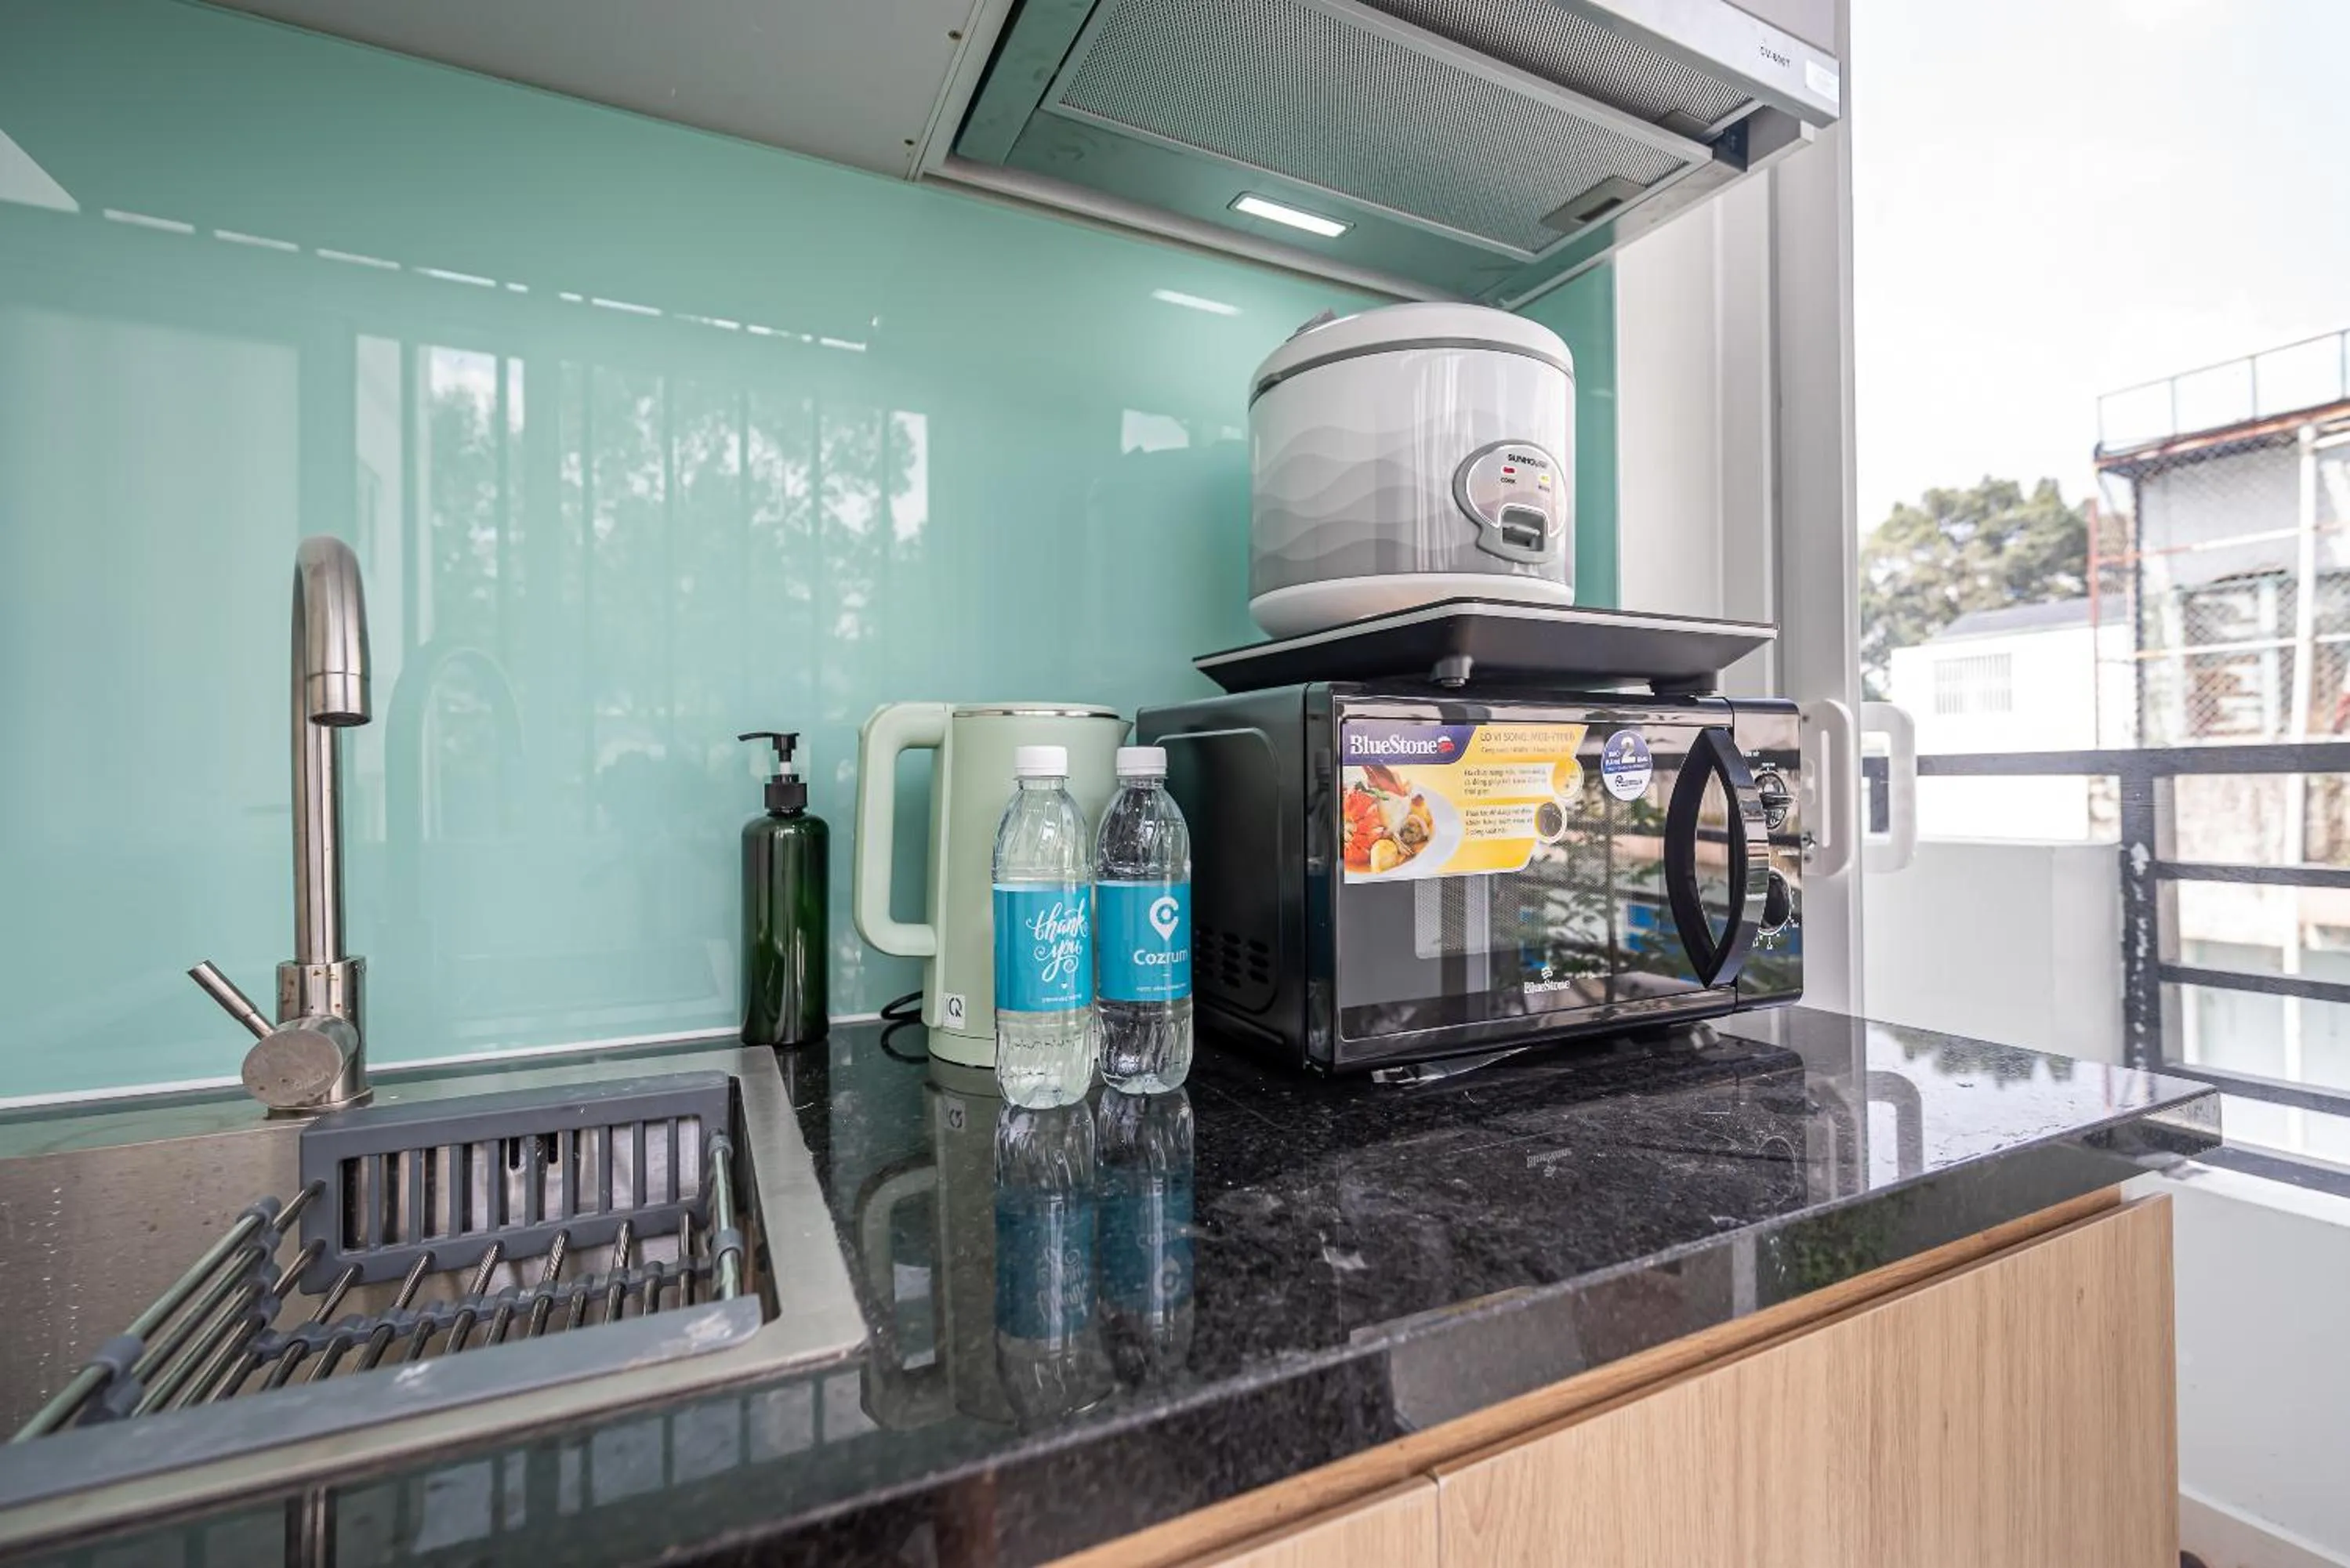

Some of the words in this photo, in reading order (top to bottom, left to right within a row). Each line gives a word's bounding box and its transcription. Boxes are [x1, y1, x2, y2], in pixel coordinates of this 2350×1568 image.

[1350, 733, 1438, 755] BlueStone
[1621, 736, 1637, 764] 2
[1025, 897, 1090, 941] thank
[1033, 940, 1082, 982] you
